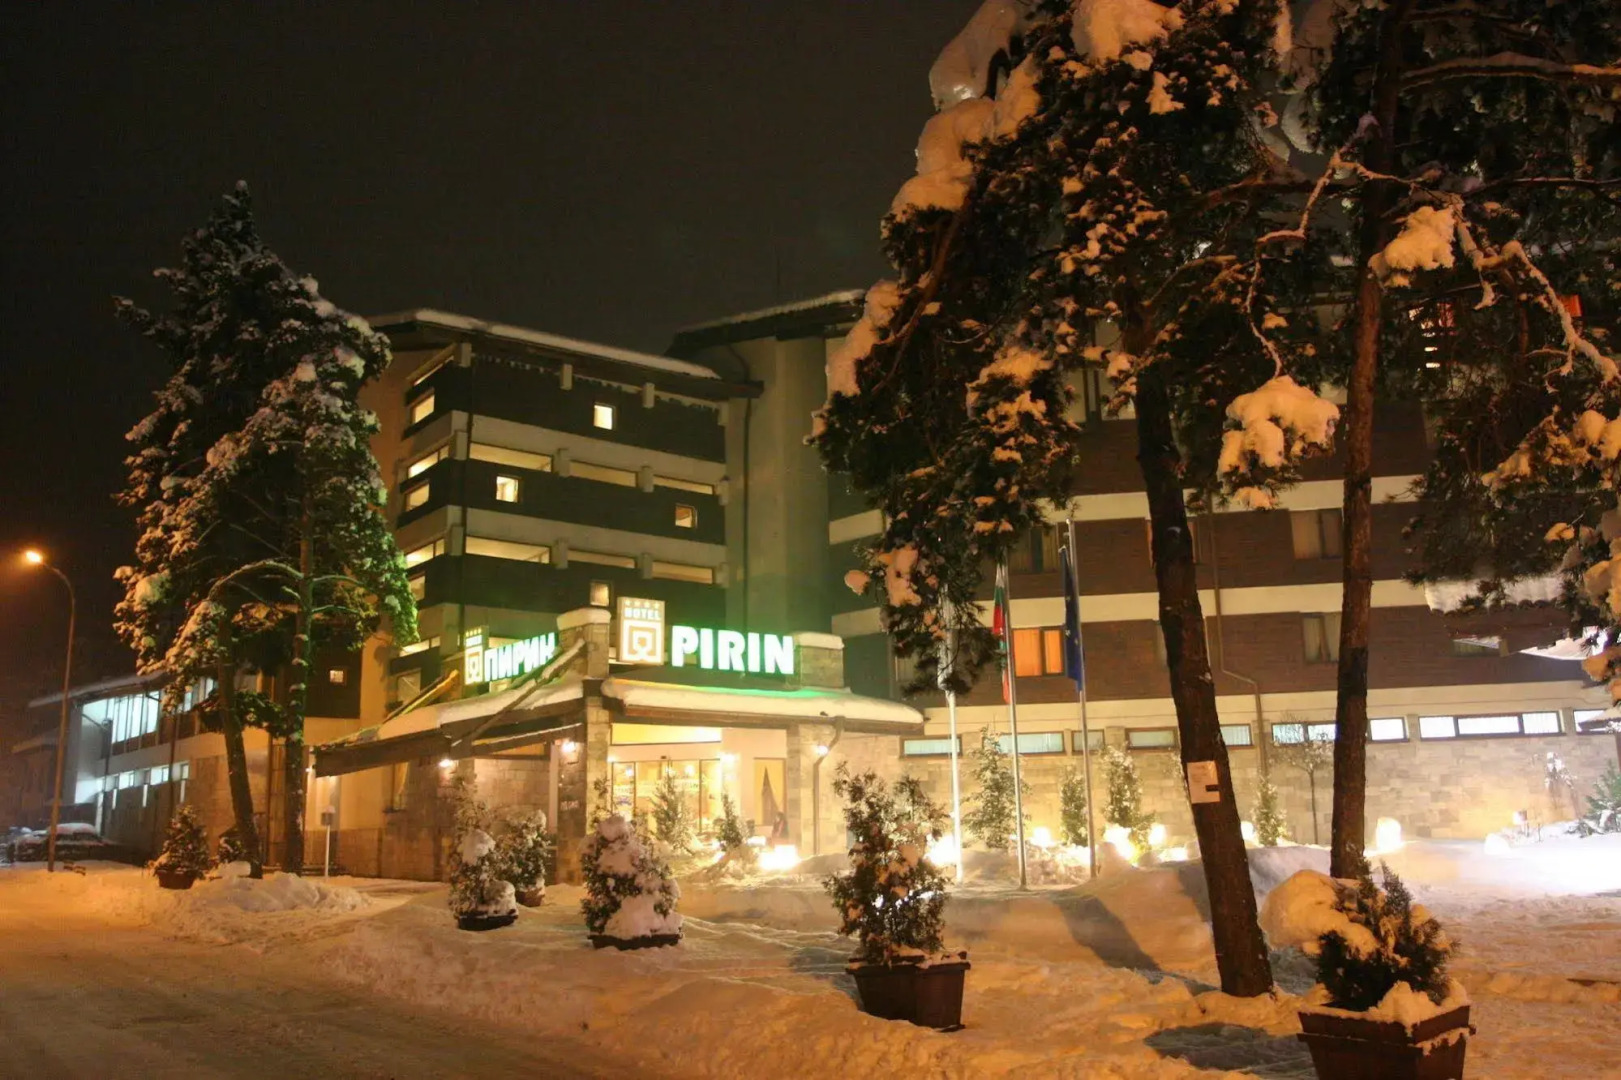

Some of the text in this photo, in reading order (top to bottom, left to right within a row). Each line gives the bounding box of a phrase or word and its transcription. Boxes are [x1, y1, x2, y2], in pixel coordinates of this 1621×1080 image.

[624, 607, 662, 620] HOTEL
[484, 632, 555, 682] ПИРИН
[671, 625, 794, 675] PIRIN
